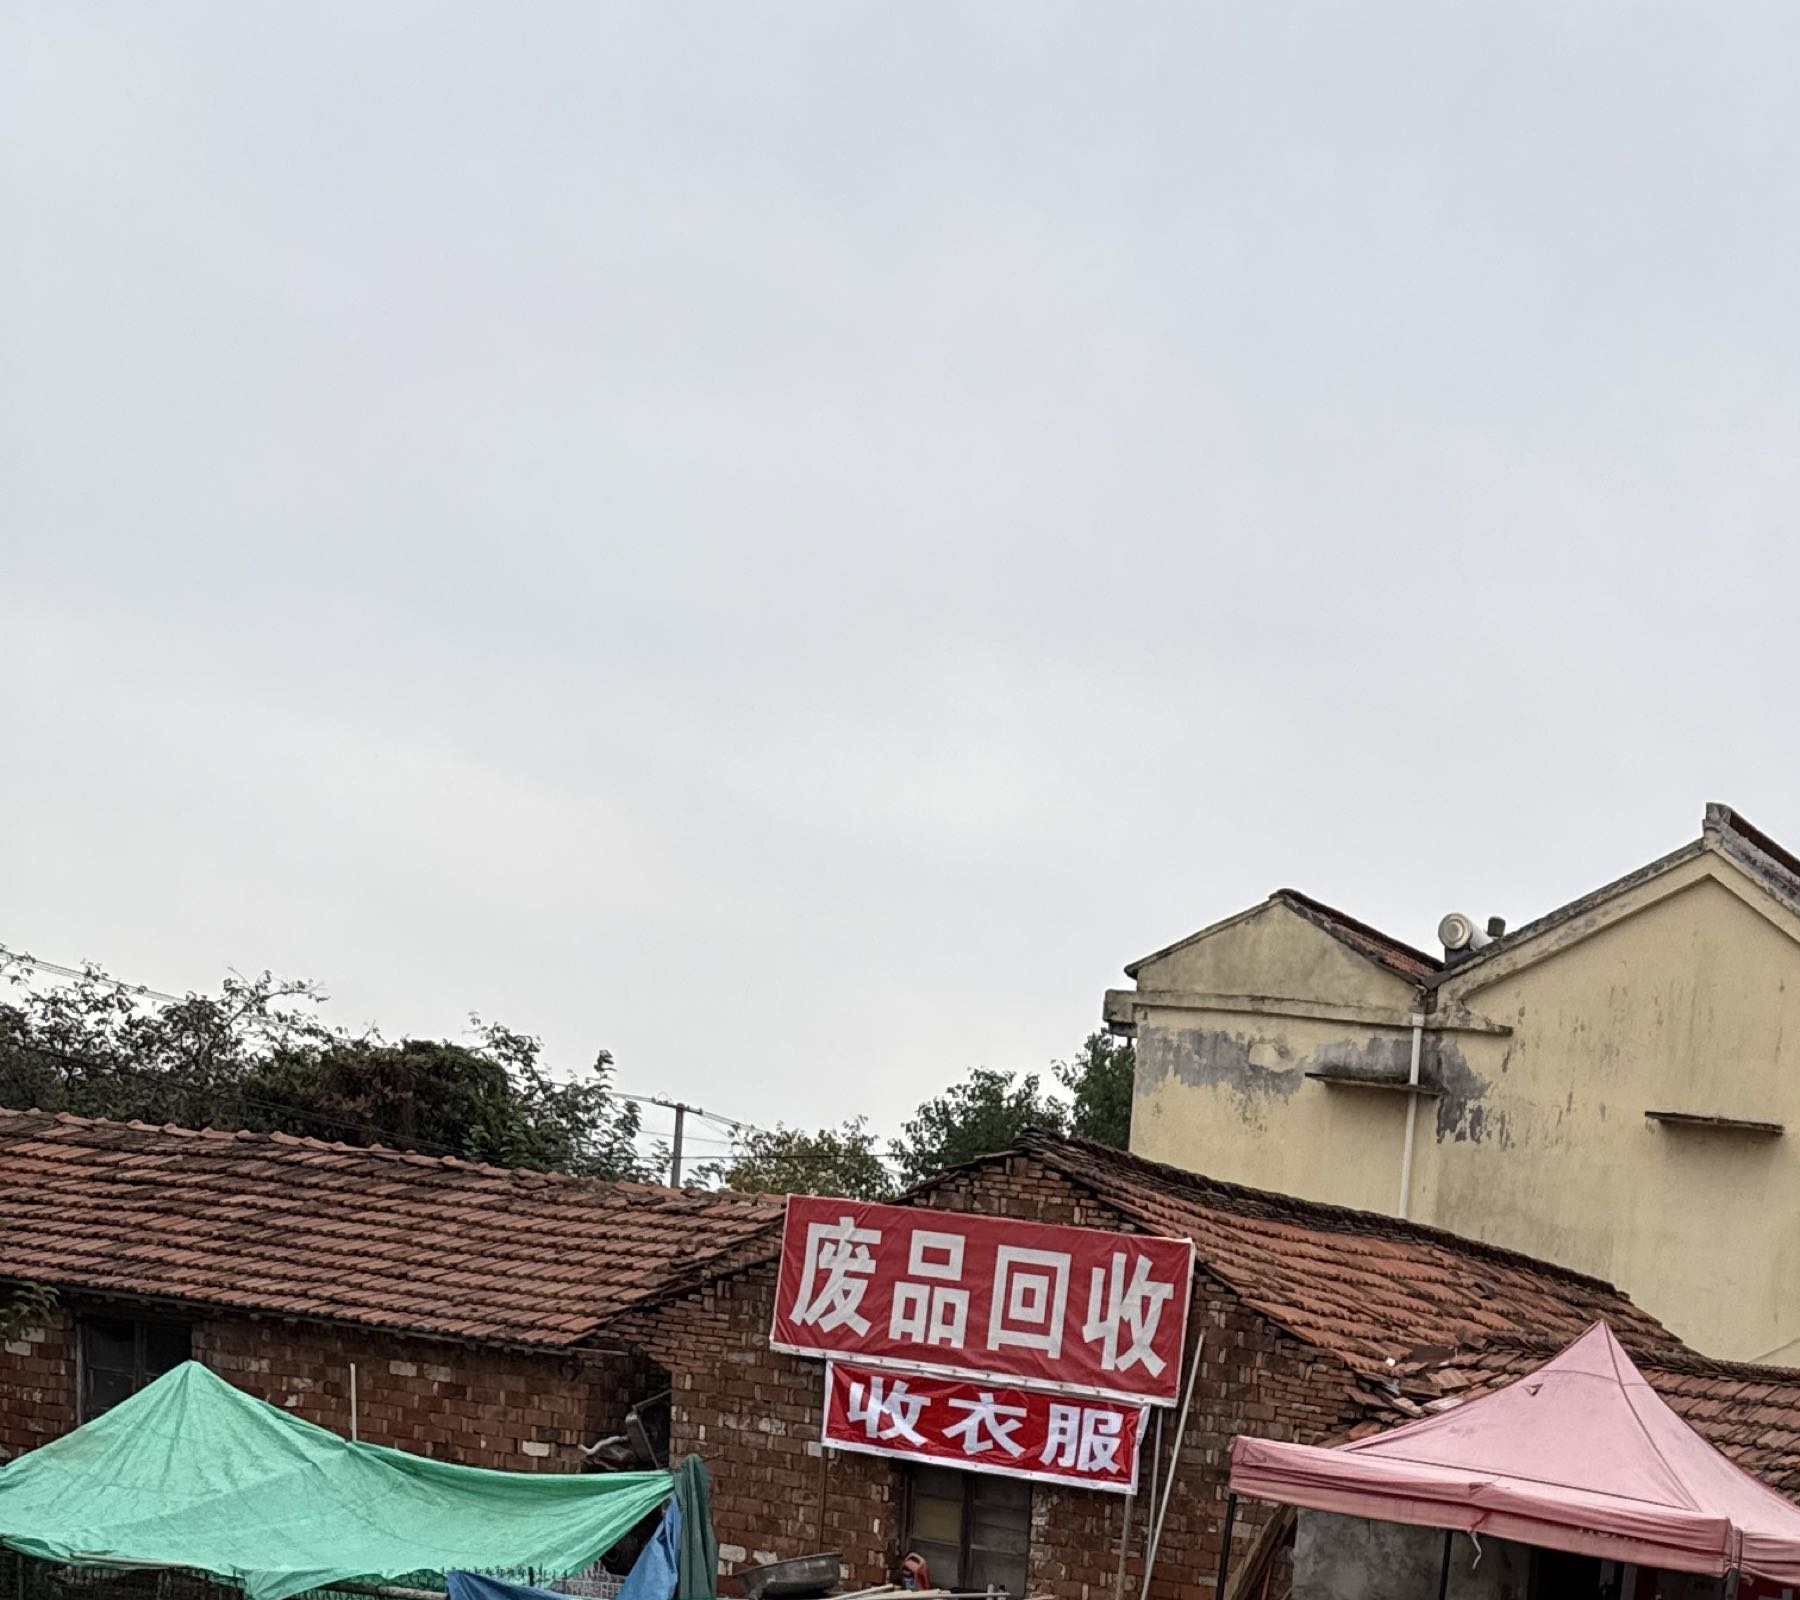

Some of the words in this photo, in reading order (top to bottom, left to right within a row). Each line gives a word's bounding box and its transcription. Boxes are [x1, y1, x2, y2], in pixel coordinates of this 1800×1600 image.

[788, 1217, 1174, 1378] 废品回收
[847, 1375, 1123, 1474] 收衣服
